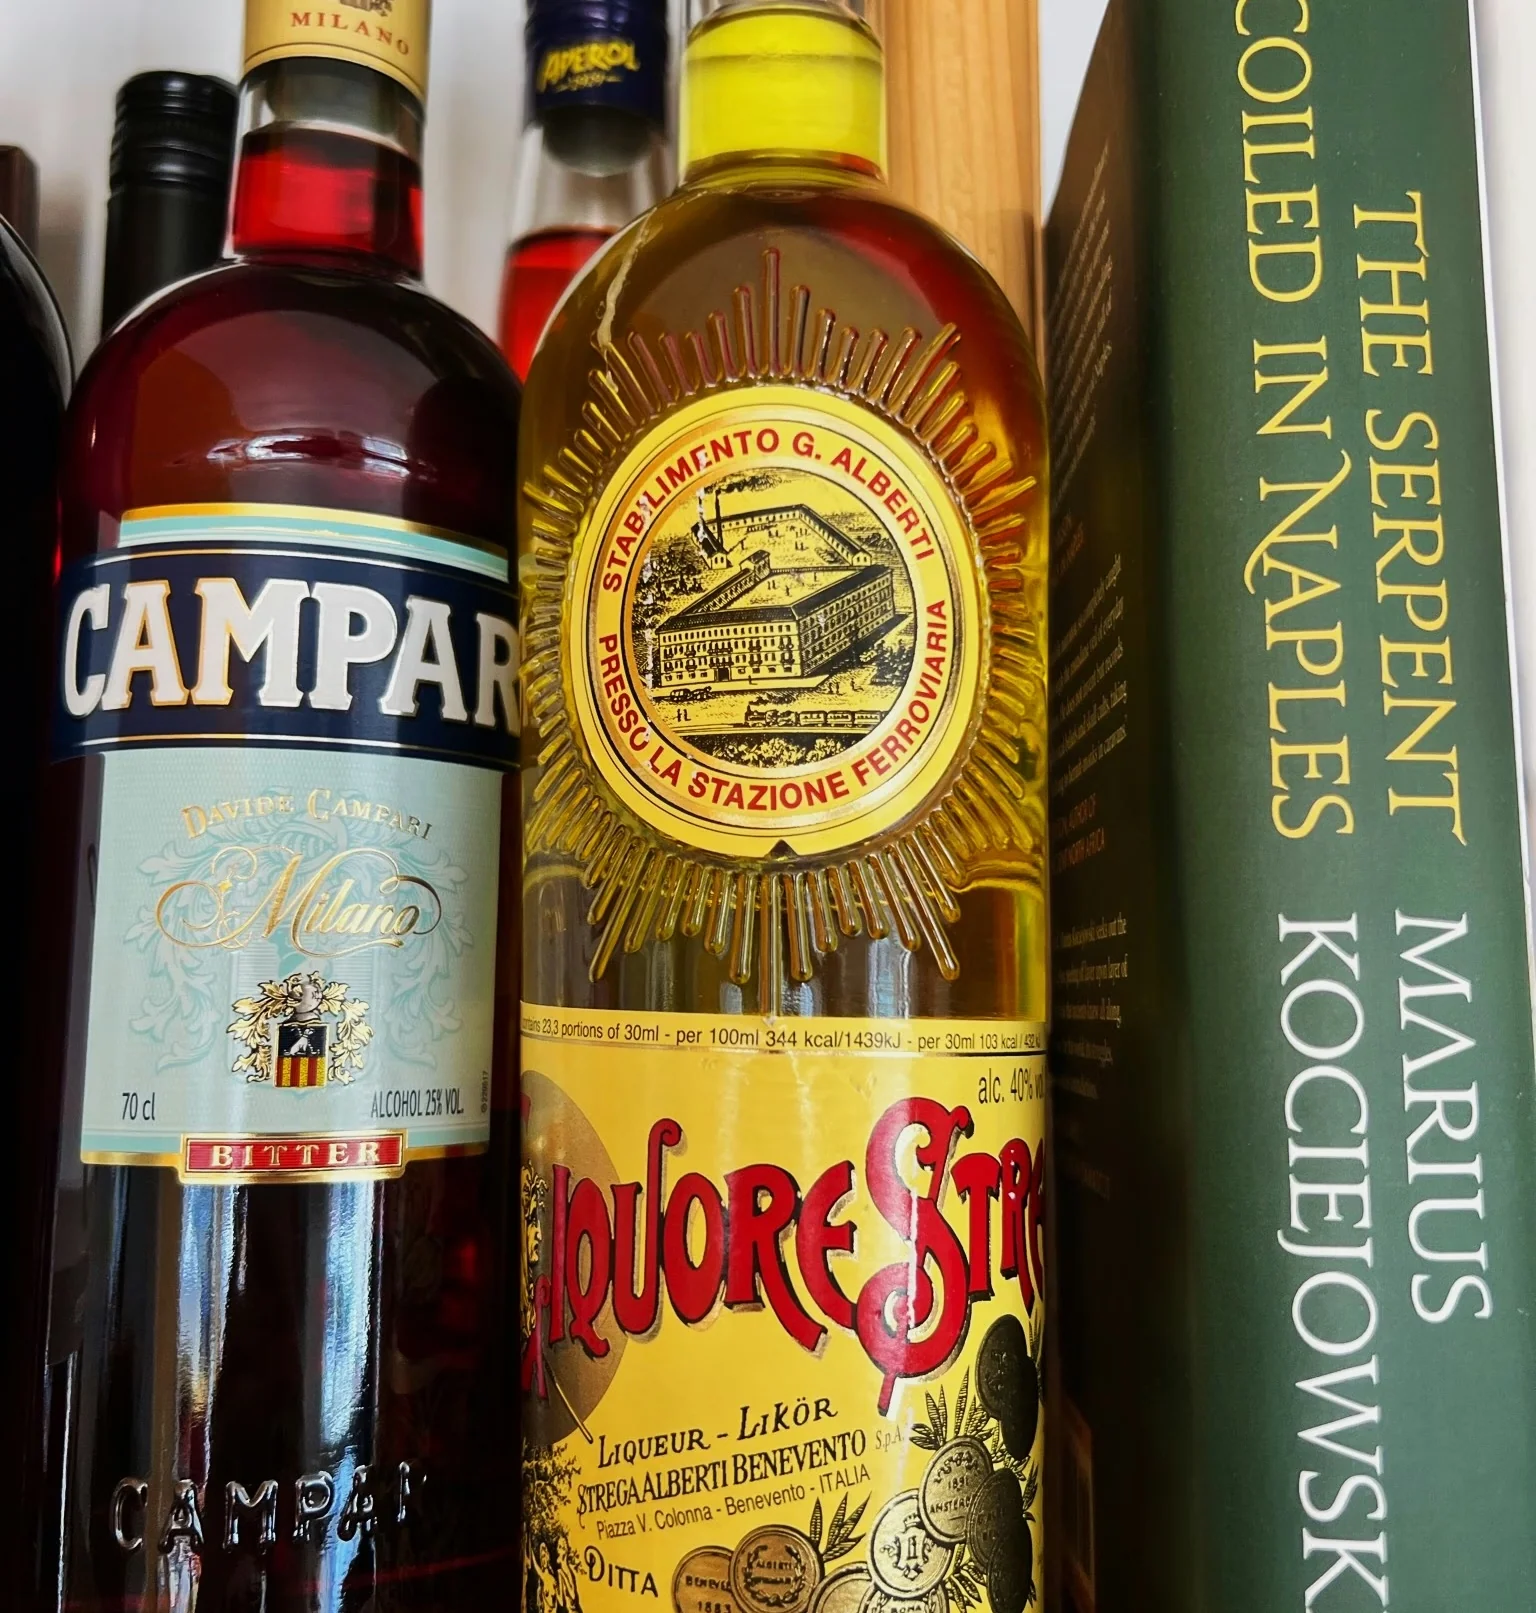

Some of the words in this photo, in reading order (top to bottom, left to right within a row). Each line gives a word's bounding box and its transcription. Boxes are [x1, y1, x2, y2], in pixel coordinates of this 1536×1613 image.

[291, 12, 410, 56] MILANO
[537, 41, 641, 93] APEROL
[1235, 0, 1324, 304] COILED
[1353, 190, 1433, 378] THE
[1253, 335, 1334, 441] IN
[602, 428, 780, 593] STABILIMENTO
[792, 431, 822, 461] G.
[830, 447, 935, 561] ALBERTI
[62, 577, 521, 738] CAMPAR
[1243, 448, 1355, 840] NAPLES
[1364, 409, 1468, 846] SERPENT
[599, 633, 649, 752] PRESSO
[648, 745, 683, 787] LA
[687, 771, 850, 811] STAZIONE
[851, 600, 947, 788] FERROVIARIA
[181, 795, 295, 839] DAVIDE
[307, 788, 432, 841] CAMPARI
[156, 845, 442, 958] Milano
[542, 1018, 558, 1035] 23,3
[561, 1020, 603, 1038] portions
[607, 1023, 620, 1040] of
[624, 1024, 659, 1042] 30ml
[676, 1029, 703, 1046] per
[709, 1028, 759, 1046] 100ml
[765, 1030, 798, 1047] 344
[804, 1030, 901, 1048] kcal/1439kJ
[918, 1036, 941, 1052] per
[945, 1033, 975, 1050] 30ml
[980, 1033, 998, 1050] 103
[1001, 1033, 1018, 1050] kcal
[122, 1092, 139, 1121] 70
[142, 1091, 155, 1121] cl
[371, 1089, 423, 1118] ALCOHOL
[425, 1088, 443, 1117] 25%
[445, 1087, 465, 1115] VOL.
[978, 1068, 1005, 1104] alc.
[1010, 1067, 1034, 1102] 40%
[1395, 909, 1493, 1325] MARIUS
[211, 1141, 381, 1169] BITTER
[1276, 911, 1390, 1613] KOCIEJOWSK
[577, 1475, 644, 1529] STREGA
[641, 1458, 728, 1504] ALBERTI
[732, 1429, 867, 1484] BENEVENTO
[597, 1428, 712, 1469] LIQUEUR
[736, 1396, 838, 1441] LIKÖR
[109, 1461, 427, 1553] CAMPA
[597, 1518, 636, 1541] Piazza
[637, 1513, 653, 1533] V.
[655, 1505, 713, 1530] Colonna
[724, 1485, 806, 1516] Benevento
[818, 1462, 871, 1495] ITALIA
[584, 1544, 659, 1598] DITTA
